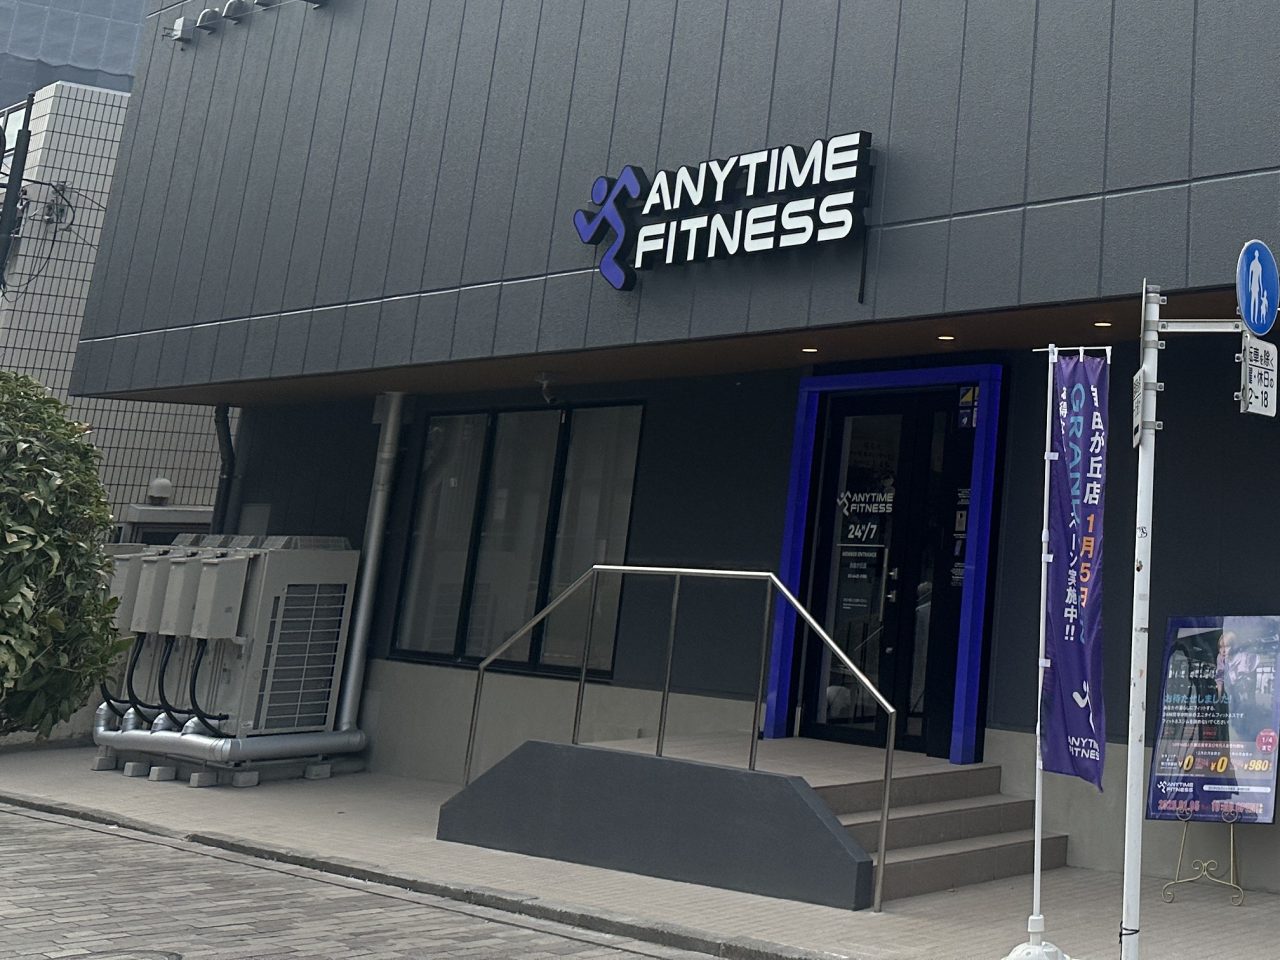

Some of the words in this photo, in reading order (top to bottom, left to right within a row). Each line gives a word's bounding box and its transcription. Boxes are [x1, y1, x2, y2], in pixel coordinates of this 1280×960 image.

[641, 132, 861, 215] ANYTIME
[634, 191, 855, 269] FITNESS
[850, 503, 893, 513] FITNESS
[851, 493, 894, 503] ANYTIME
